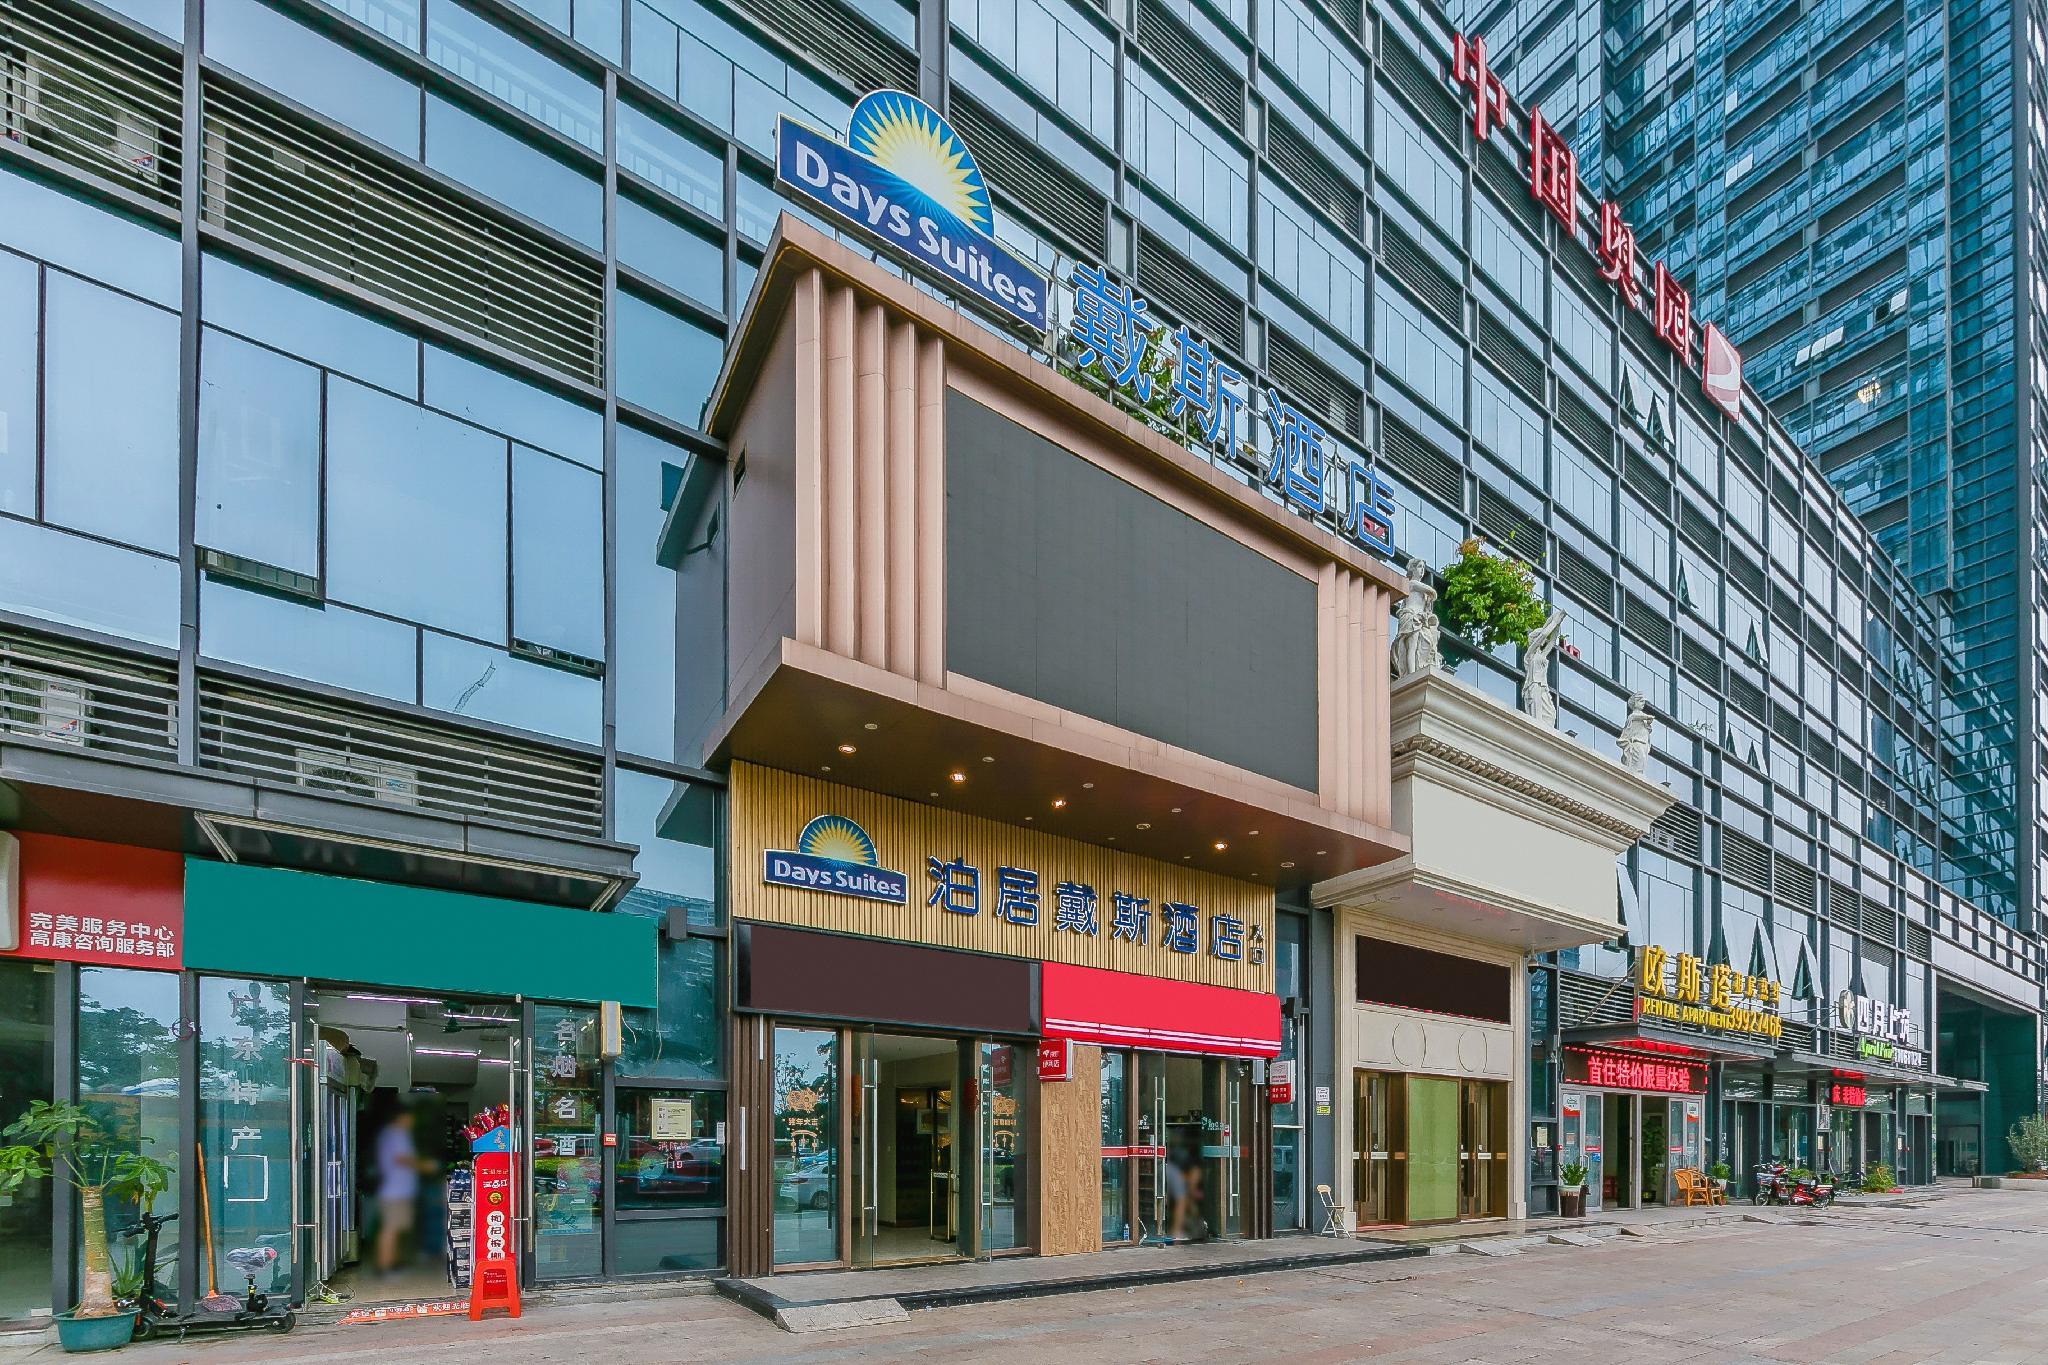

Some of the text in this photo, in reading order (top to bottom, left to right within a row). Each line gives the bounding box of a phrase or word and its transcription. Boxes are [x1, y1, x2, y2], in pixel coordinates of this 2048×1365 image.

[795, 140, 1040, 314] Days Suites
[1071, 259, 1395, 556] 戴斯酒店
[774, 859, 901, 897] Days Suites
[927, 855, 1245, 960] 泊居戴斯酒店
[30, 912, 174, 941] 完美服务中心
[30, 929, 175, 957] 高康咨询服务部
[1641, 945, 1732, 1009] 欧斯塔
[552, 1018, 576, 1156] 名烟名酒
[1587, 1055, 1690, 1092] 首住特价限量体验
